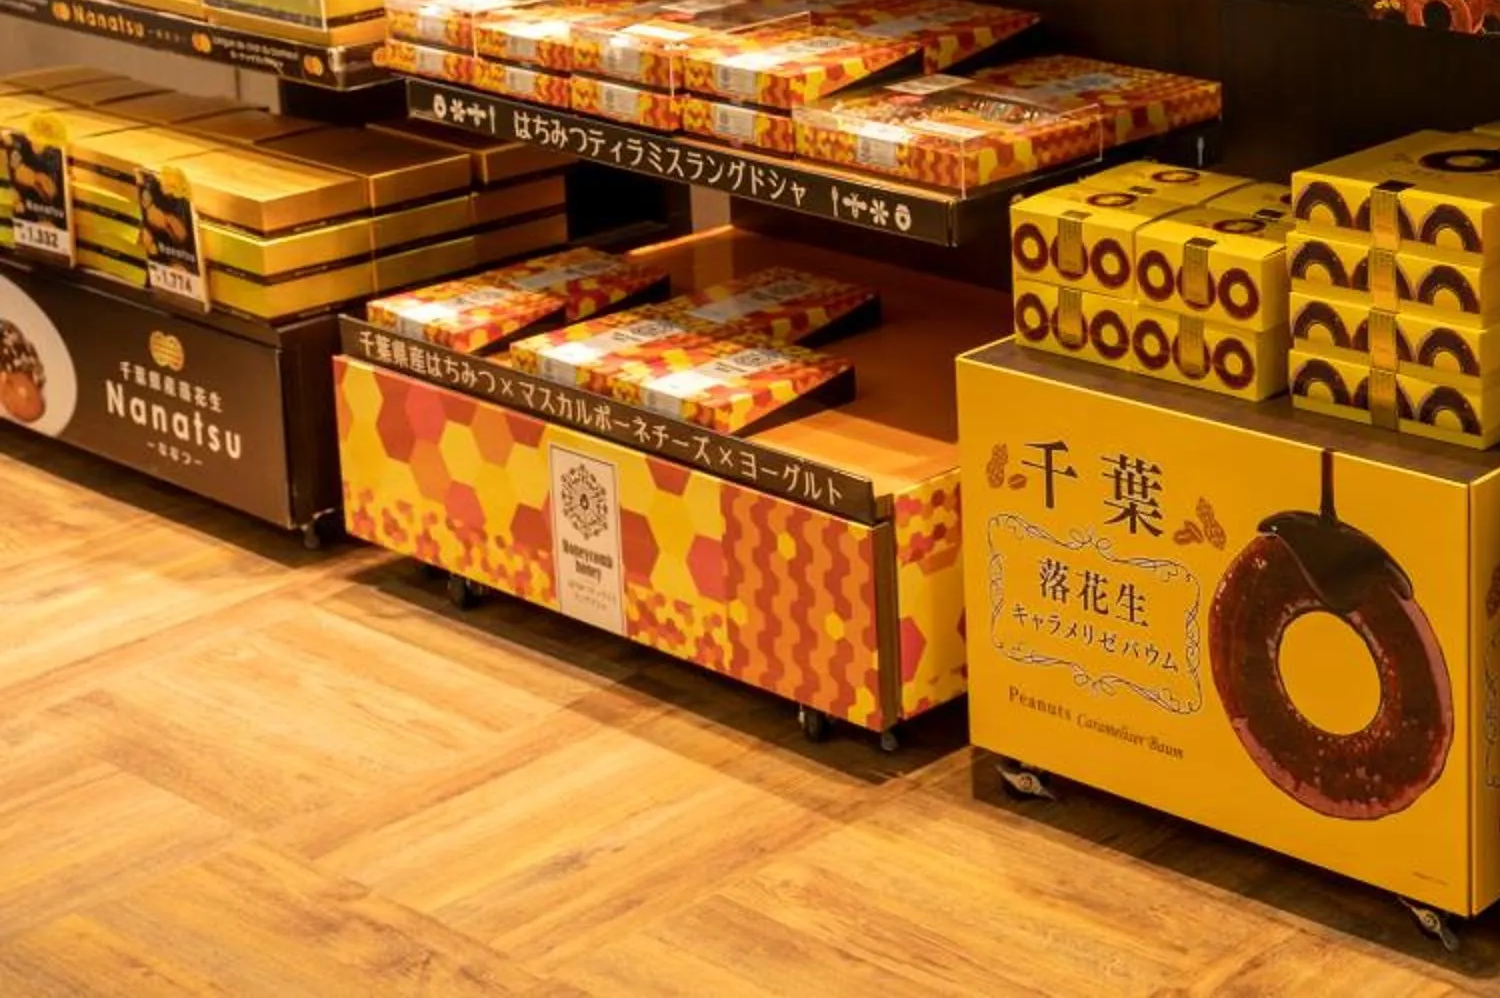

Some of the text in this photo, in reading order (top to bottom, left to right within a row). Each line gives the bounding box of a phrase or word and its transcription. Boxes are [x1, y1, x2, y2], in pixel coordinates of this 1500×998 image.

[71, 5, 145, 38] Nanatsu
[513, 110, 807, 207] はちみつティラミスラングドシャ
[105, 379, 242, 460] Nanatsu
[1021, 440, 1164, 539] 千葉
[1039, 558, 1150, 629] 落花生
[1011, 602, 1181, 674] キャラメリゼバウム
[1008, 685, 1072, 721] Peanuts
